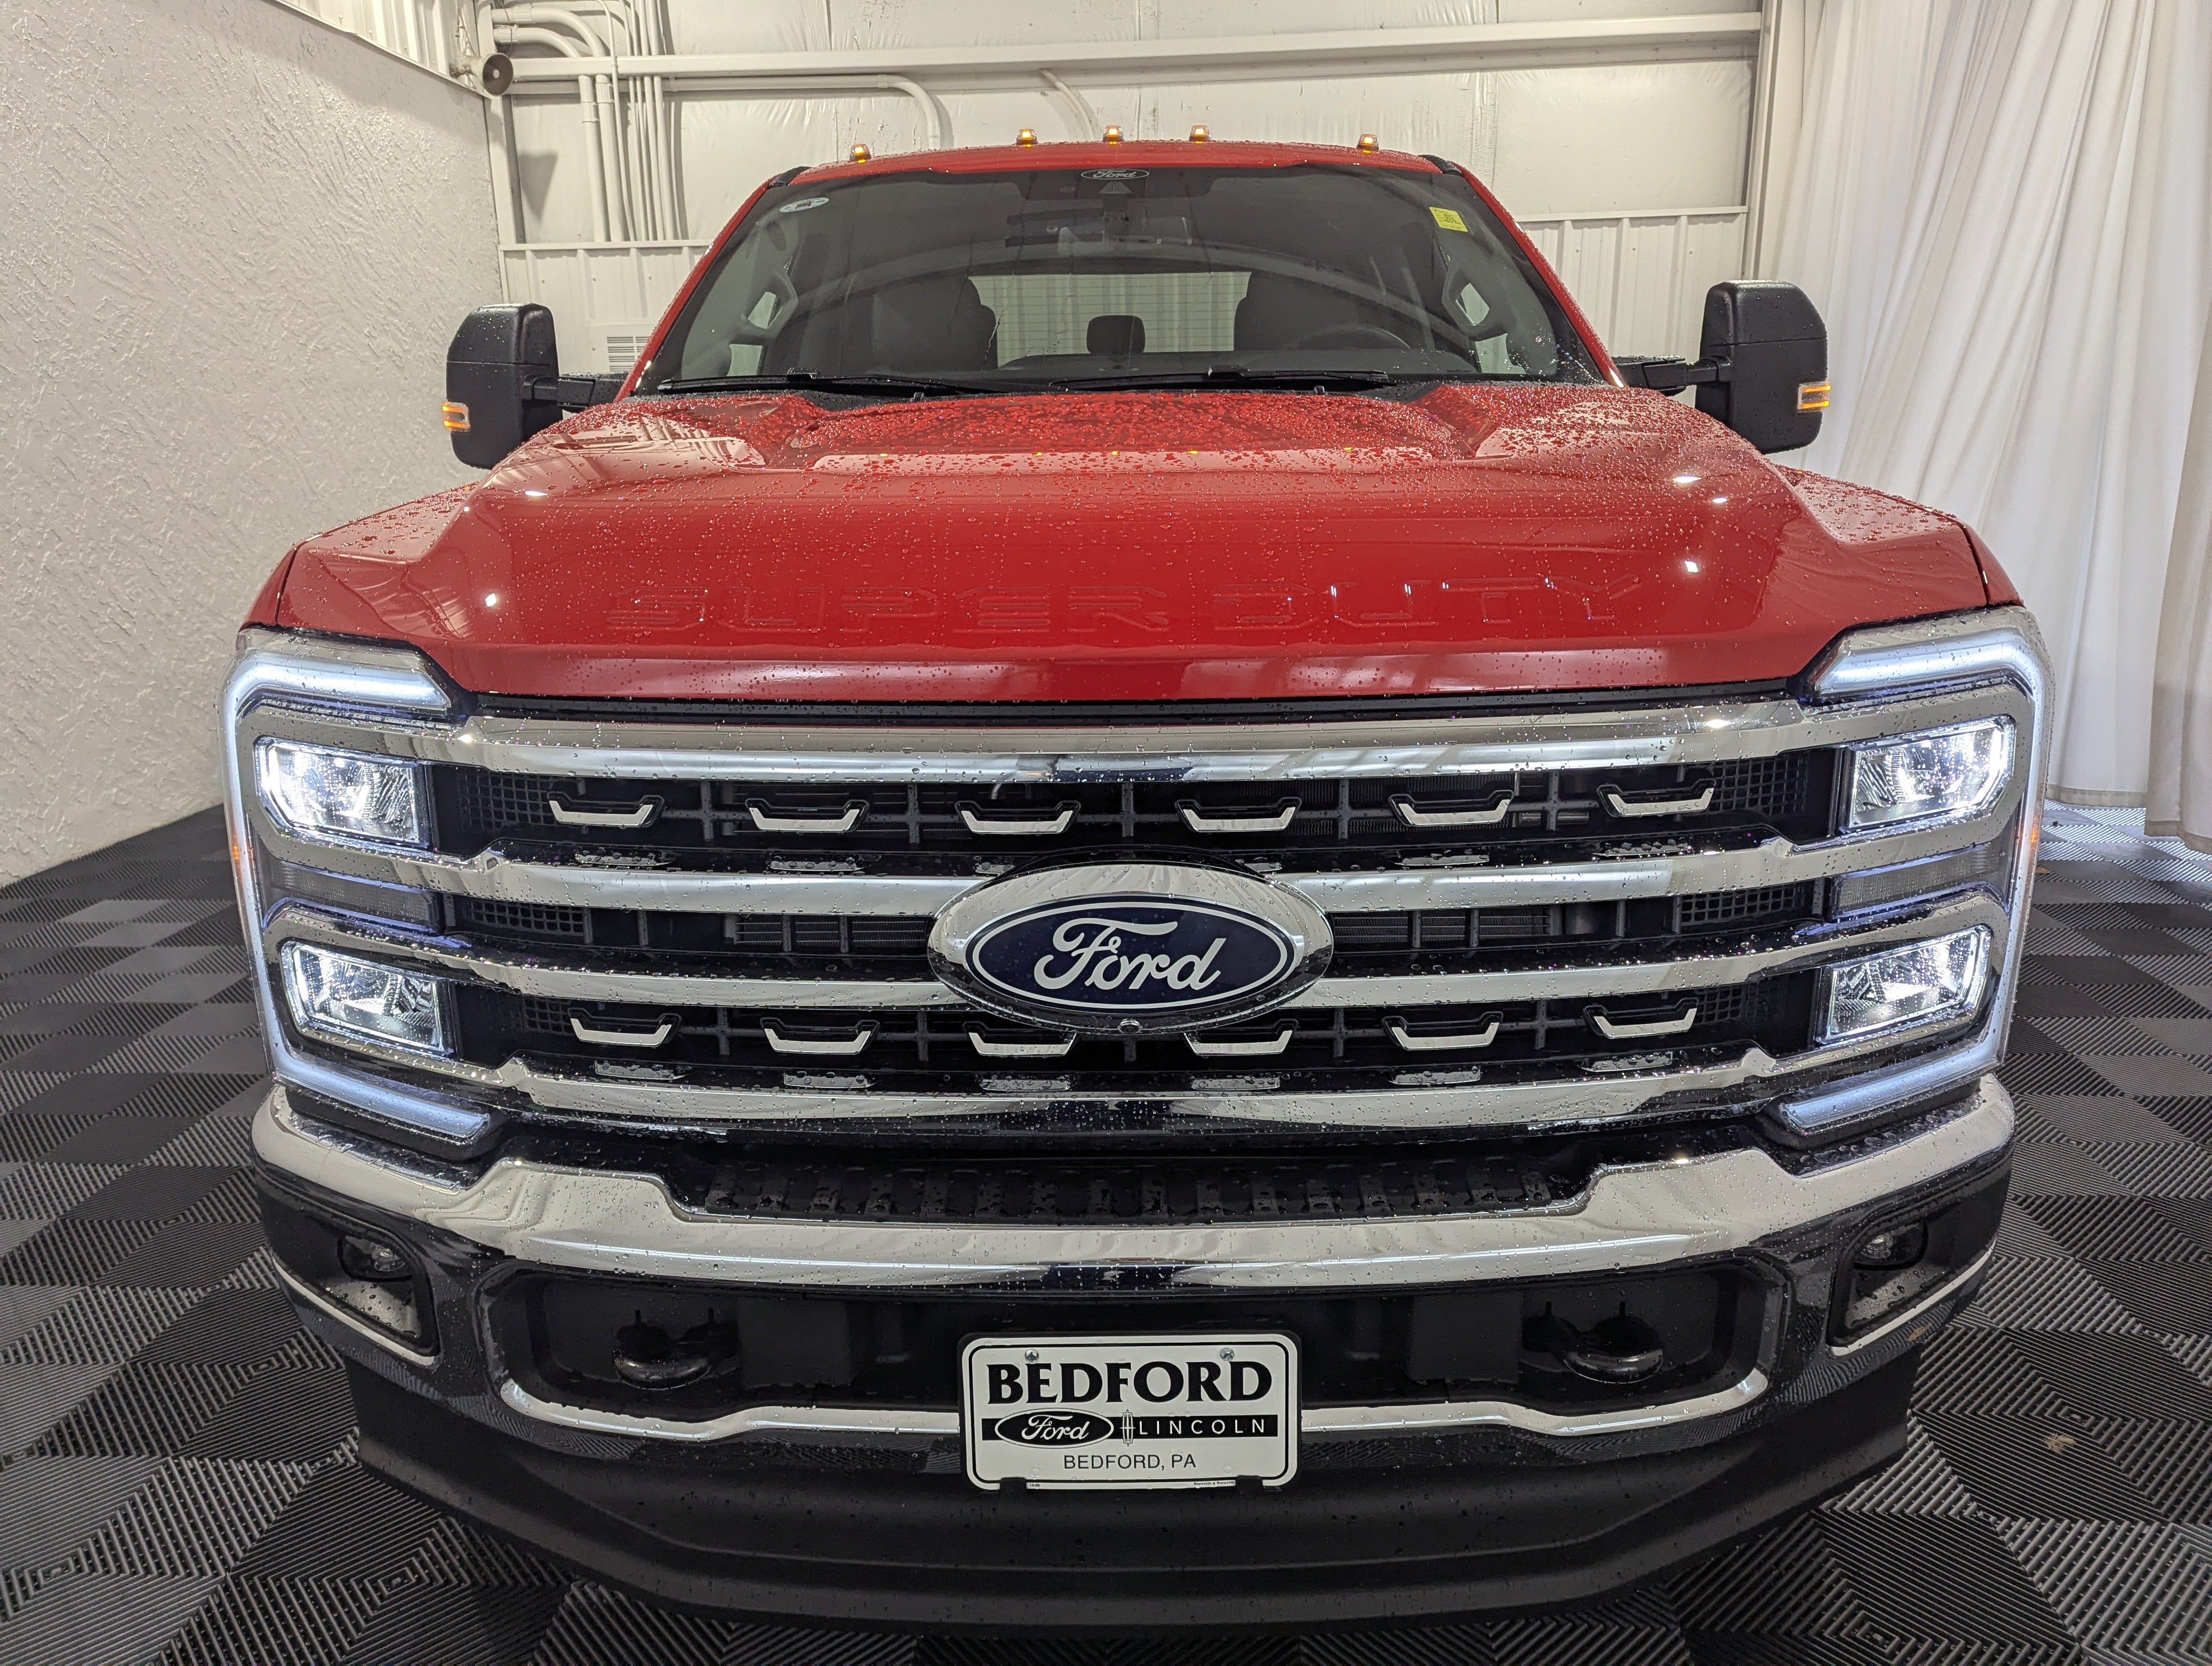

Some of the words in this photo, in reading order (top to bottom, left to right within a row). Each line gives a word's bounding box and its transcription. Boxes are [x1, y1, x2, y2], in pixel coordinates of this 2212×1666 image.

[1093, 169, 1137, 178] Ford
[607, 585, 1169, 633] SUPER
[1212, 572, 1642, 631] DUTY
[1033, 917, 1227, 990] Ford
[986, 1361, 1272, 1405] BEDFORD
[1021, 1414, 1091, 1440] Ford
[1139, 1418, 1265, 1435] LINCOLN
[1063, 1454, 1165, 1471] BEDFORD,
[1171, 1453, 1196, 1469] PA
